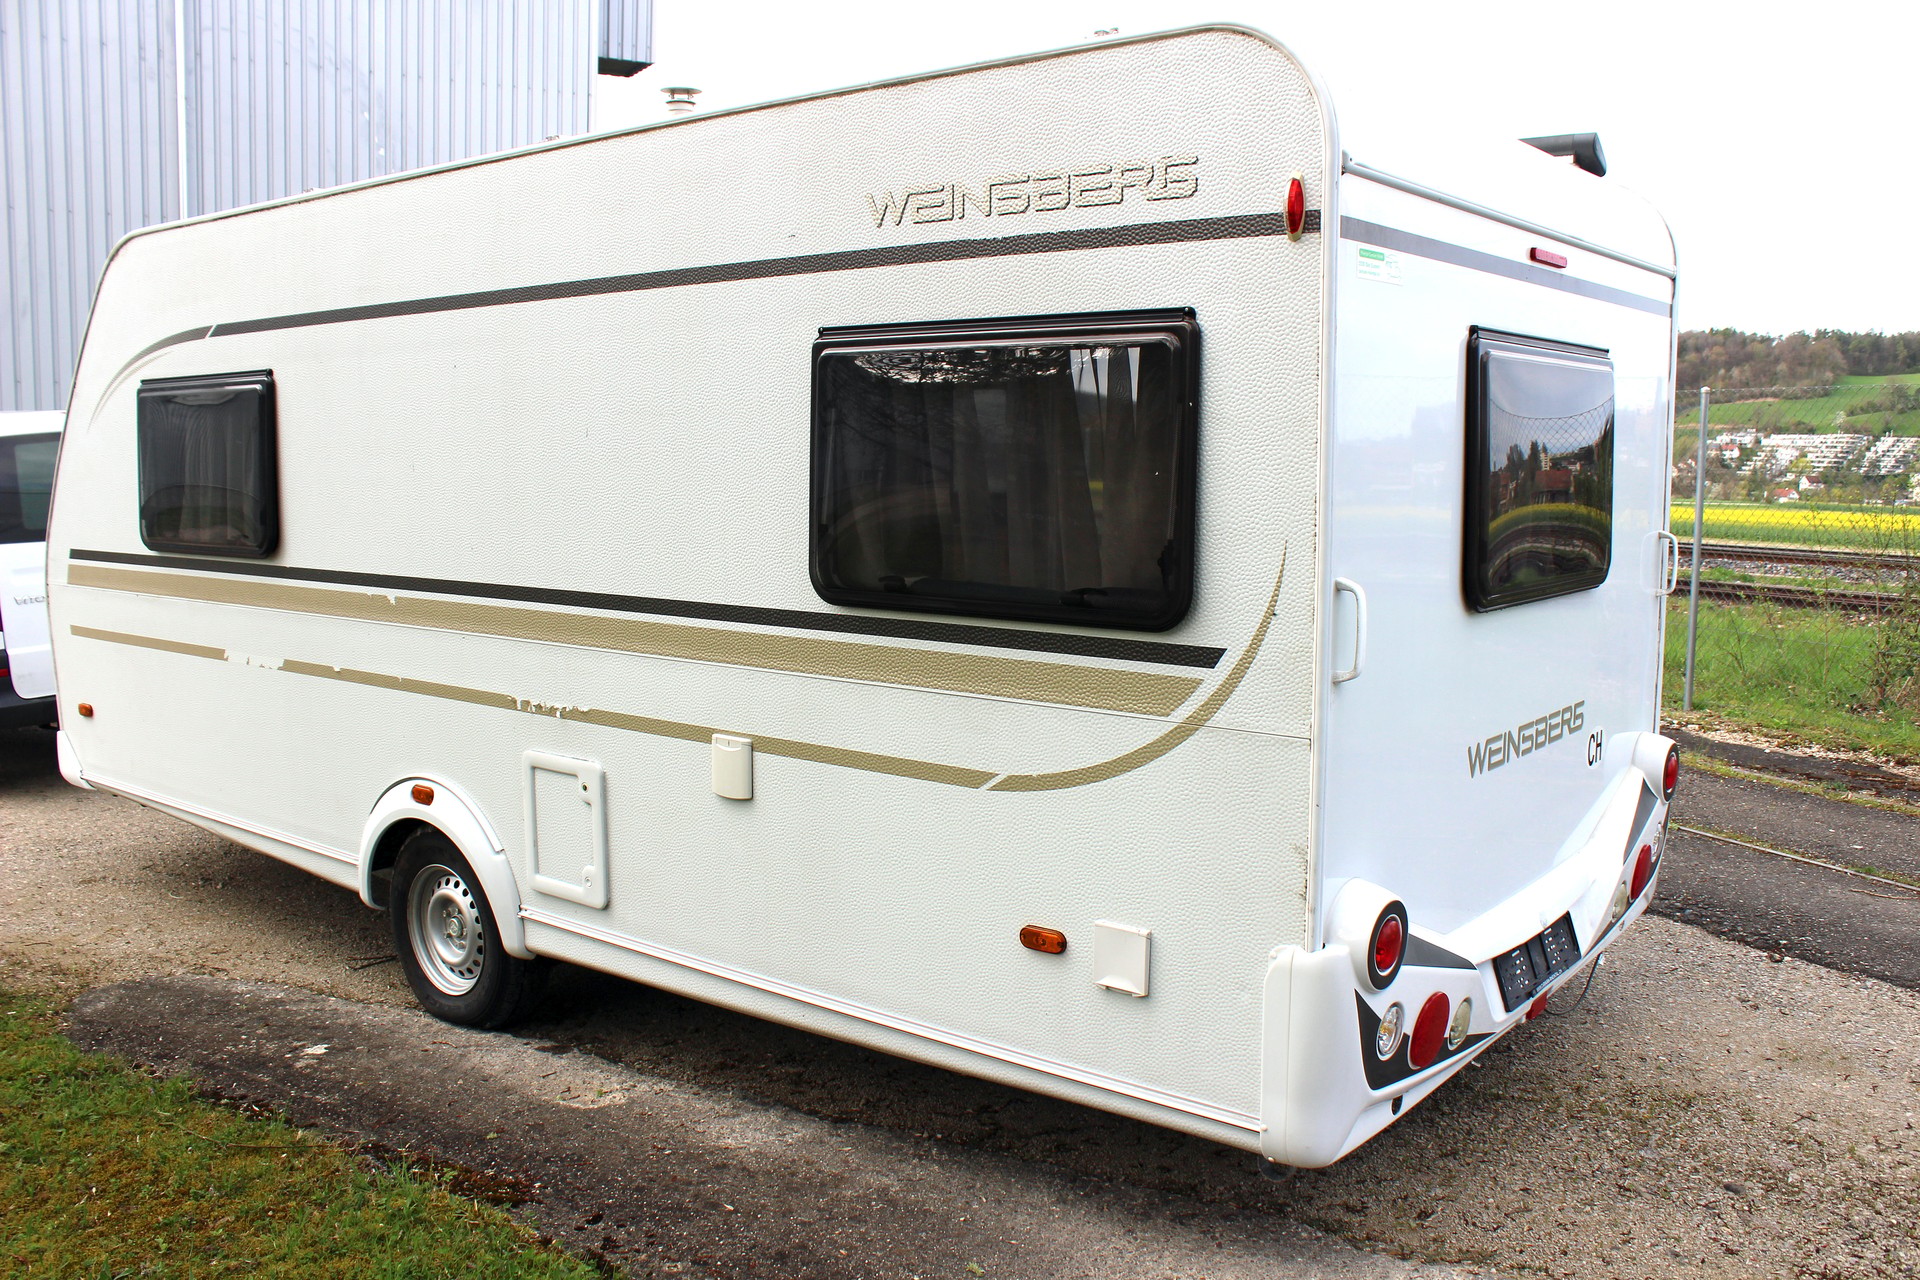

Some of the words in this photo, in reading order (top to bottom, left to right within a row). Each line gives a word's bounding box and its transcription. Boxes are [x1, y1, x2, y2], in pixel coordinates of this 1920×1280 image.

[865, 155, 1199, 228] WEINSBERG
[1467, 699, 1585, 779] WEINSBERG
[1587, 729, 1603, 767] CH
